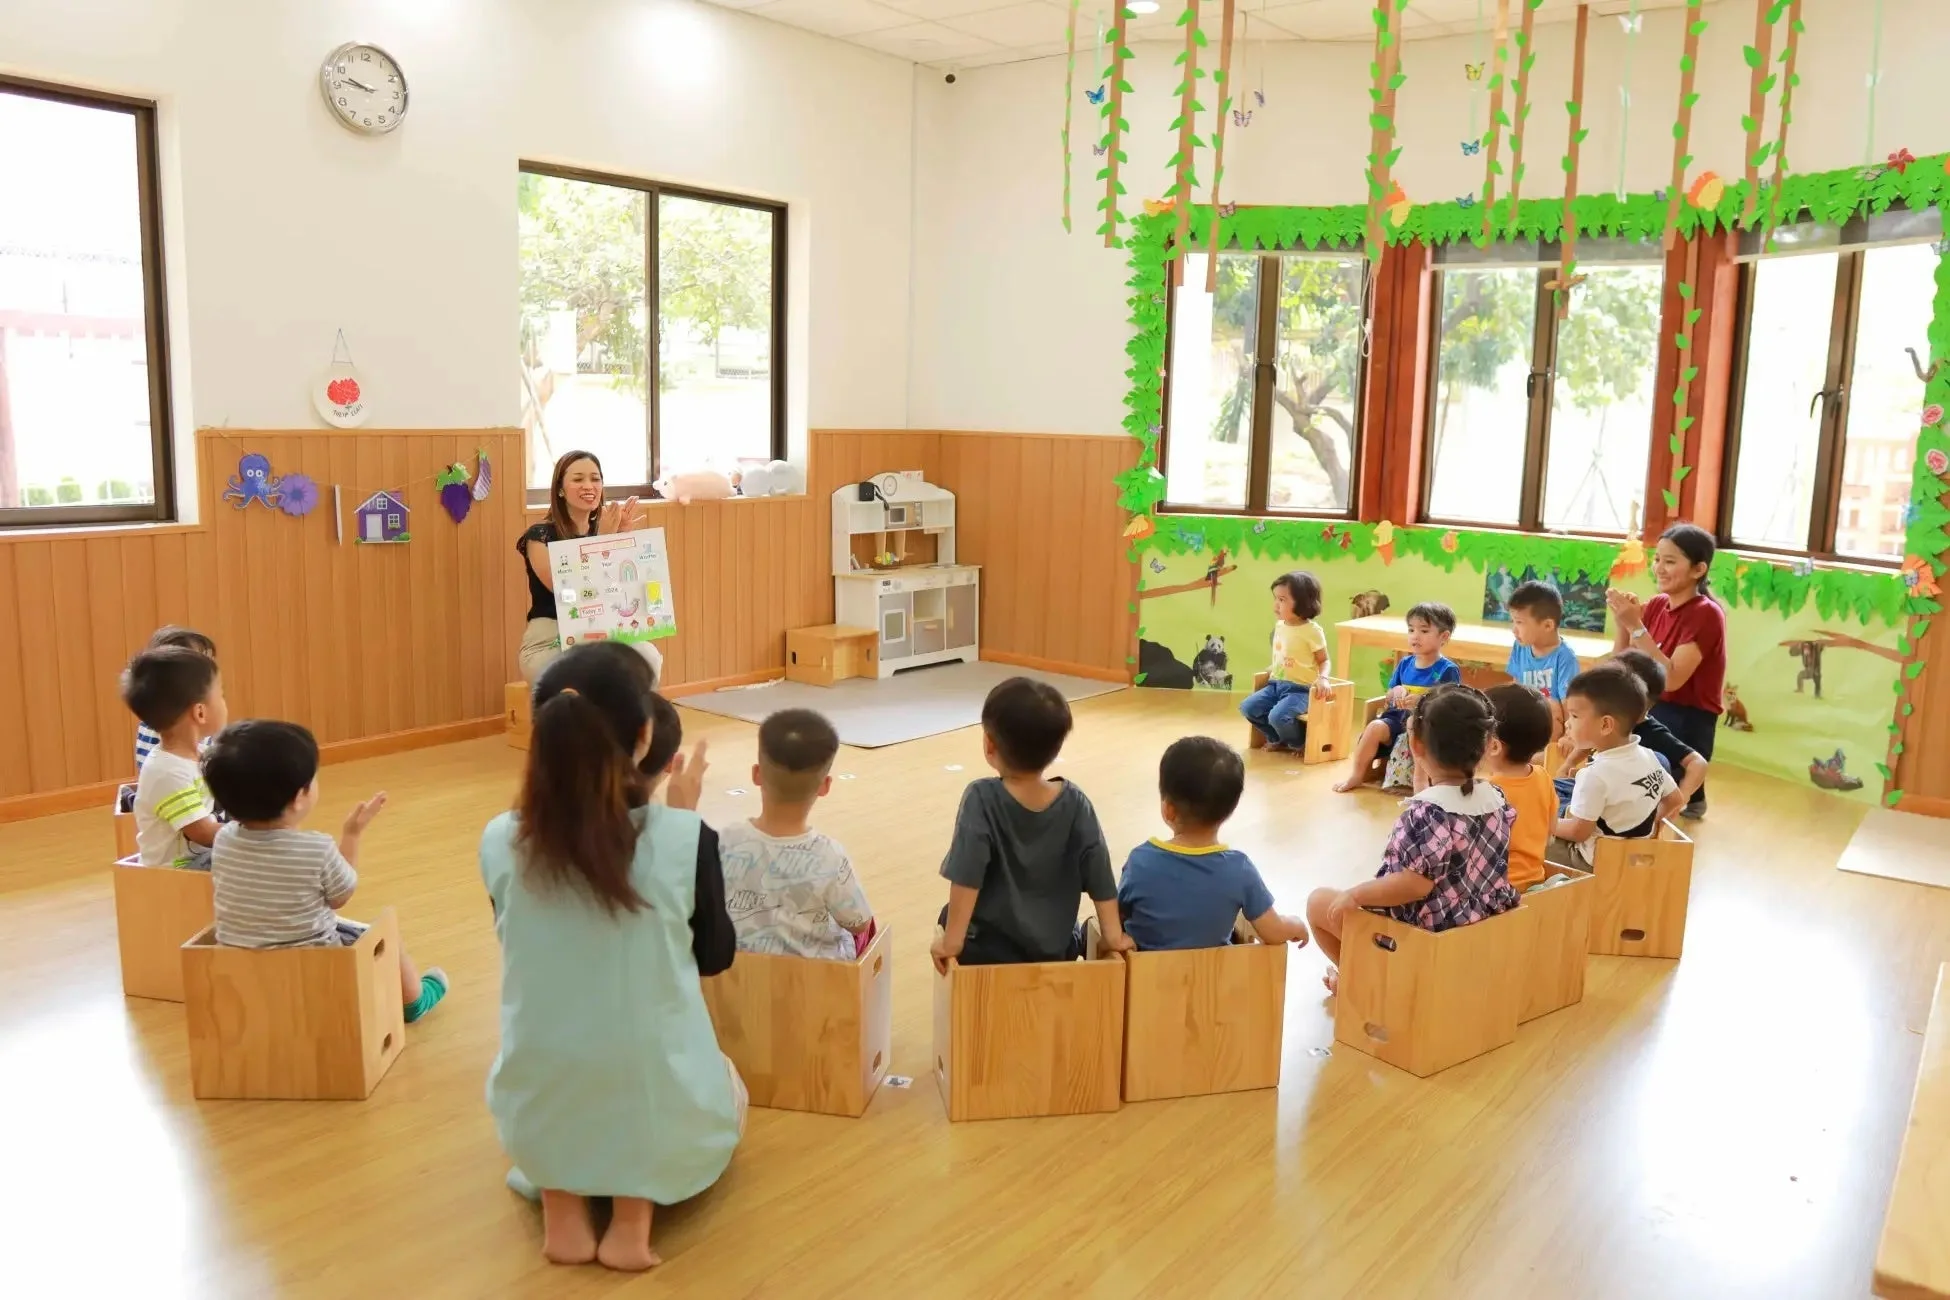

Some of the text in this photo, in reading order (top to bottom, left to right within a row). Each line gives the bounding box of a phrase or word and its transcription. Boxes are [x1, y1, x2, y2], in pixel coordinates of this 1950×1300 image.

[348, 55, 354, 63] 11
[361, 53, 371, 62] 12
[337, 66, 346, 74] 10
[388, 75, 397, 83] 2
[333, 81, 341, 89] 9
[338, 97, 347, 106] 8
[388, 106, 395, 114] 4
[349, 110, 356, 119] 7
[364, 118, 372, 126] 6
[378, 115, 386, 124] 5
[583, 590, 593, 598] 26
[728, 889, 768, 911] NIKE
